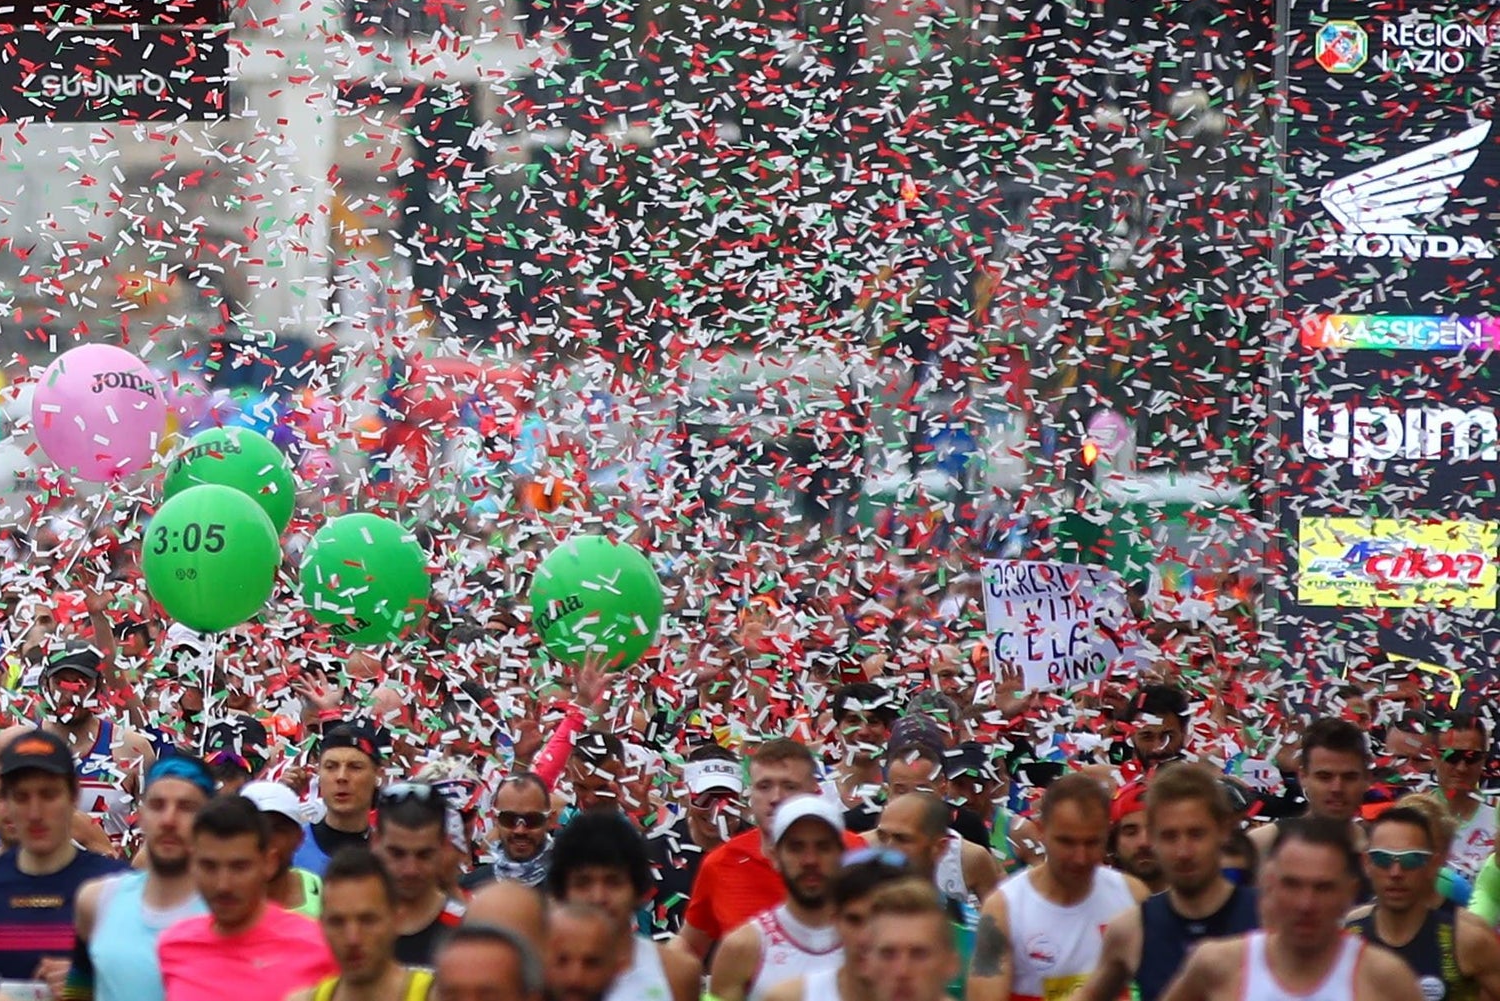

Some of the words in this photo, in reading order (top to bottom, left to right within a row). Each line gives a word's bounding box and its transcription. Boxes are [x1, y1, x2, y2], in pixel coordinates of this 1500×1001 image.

[1382, 50, 1465, 74] LAZIO
[41, 75, 168, 98] SUUNTO
[1320, 233, 1494, 259] HONDA
[1322, 316, 1482, 347] MASSIGEN
[1301, 406, 1497, 478] upim
[153, 522, 226, 556] 3:05
